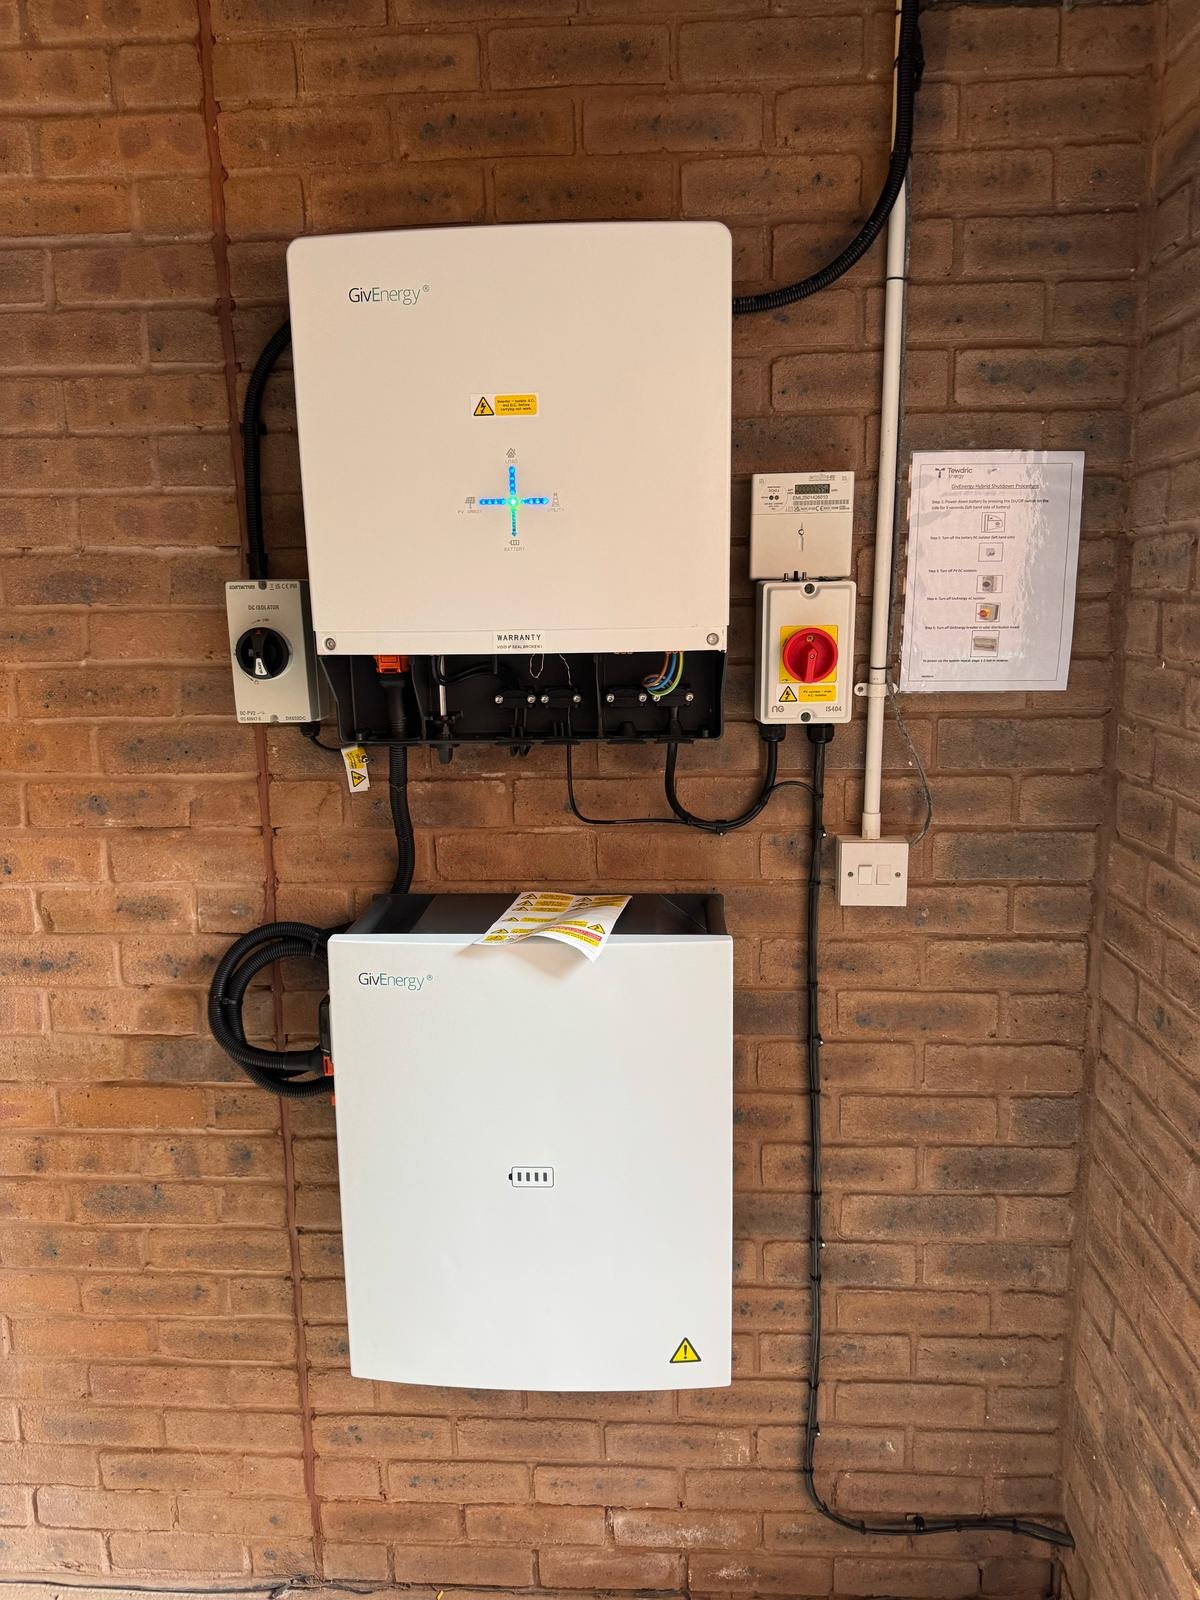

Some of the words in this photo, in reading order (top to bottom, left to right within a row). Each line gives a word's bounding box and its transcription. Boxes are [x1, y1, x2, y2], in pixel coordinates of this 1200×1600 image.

[348, 286, 421, 306] GivEnergy
[496, 633, 541, 641] WARRANTY
[358, 972, 425, 991] GivEnergy
